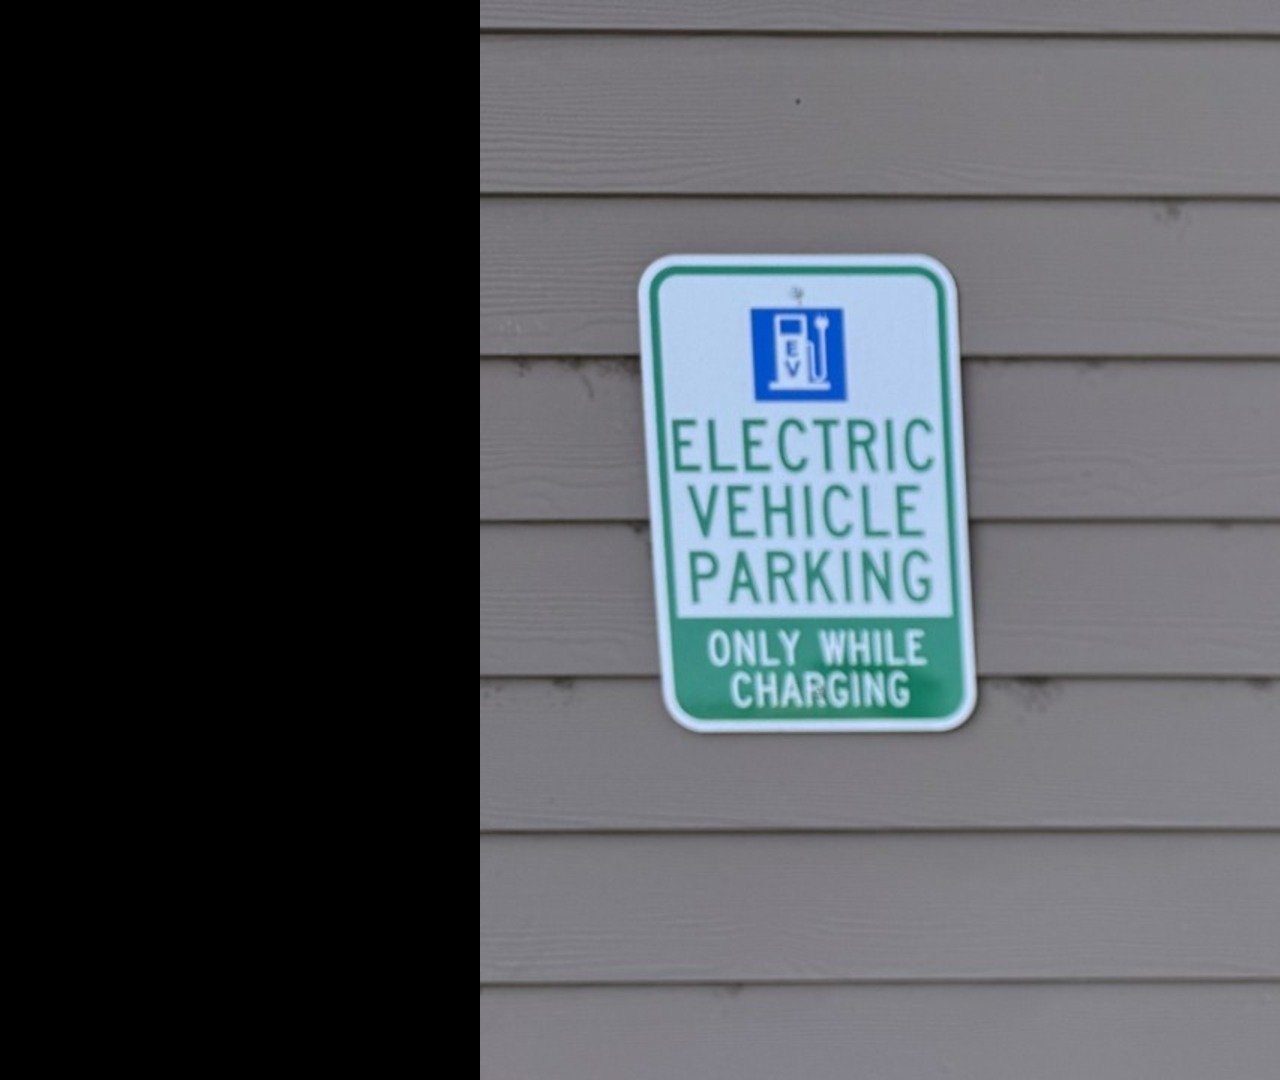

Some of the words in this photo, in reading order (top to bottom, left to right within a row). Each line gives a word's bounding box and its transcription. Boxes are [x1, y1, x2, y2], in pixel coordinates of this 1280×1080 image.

[671, 418, 936, 473] ELECTRIC
[687, 484, 926, 539] VEHICLE
[688, 550, 934, 604] PARKING
[708, 629, 800, 668] ONLY
[819, 629, 929, 667] WHILE
[731, 671, 912, 710] CHARGING
